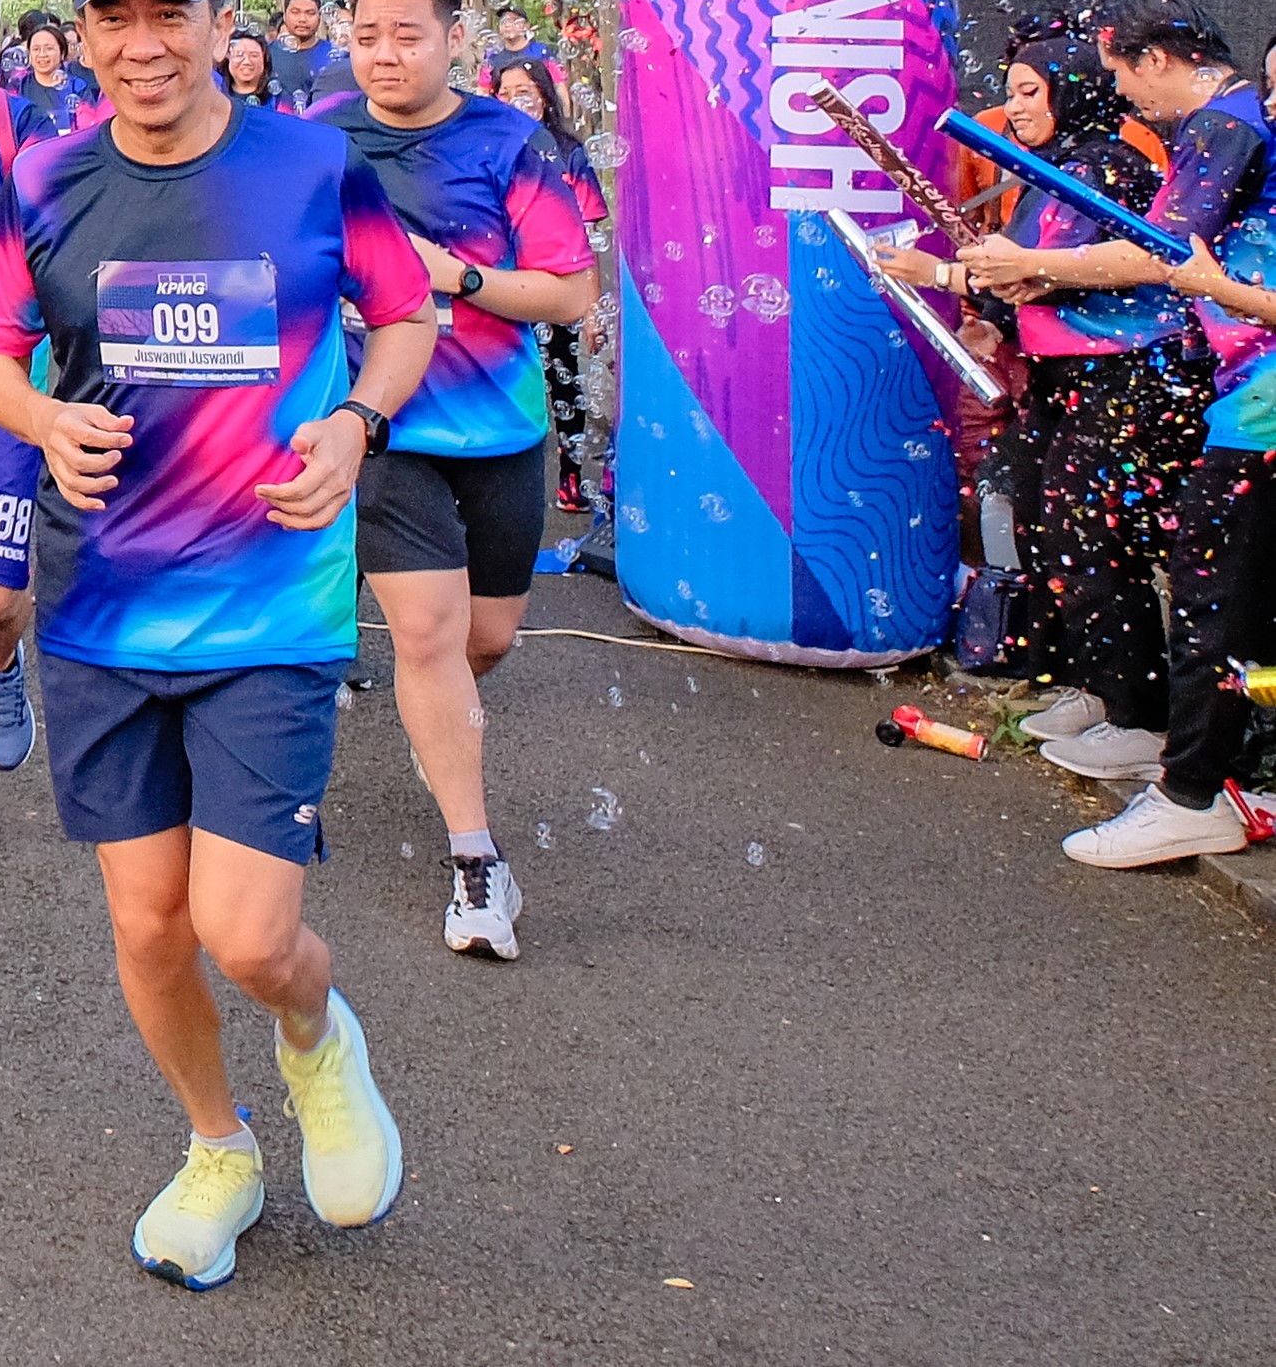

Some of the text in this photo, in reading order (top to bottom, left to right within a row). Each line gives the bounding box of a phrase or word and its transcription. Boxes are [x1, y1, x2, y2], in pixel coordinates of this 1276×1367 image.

[156, 282, 206, 295] KPMG
[152, 302, 220, 344] 099
[135, 348, 245, 365] Juswandi Juswandi
